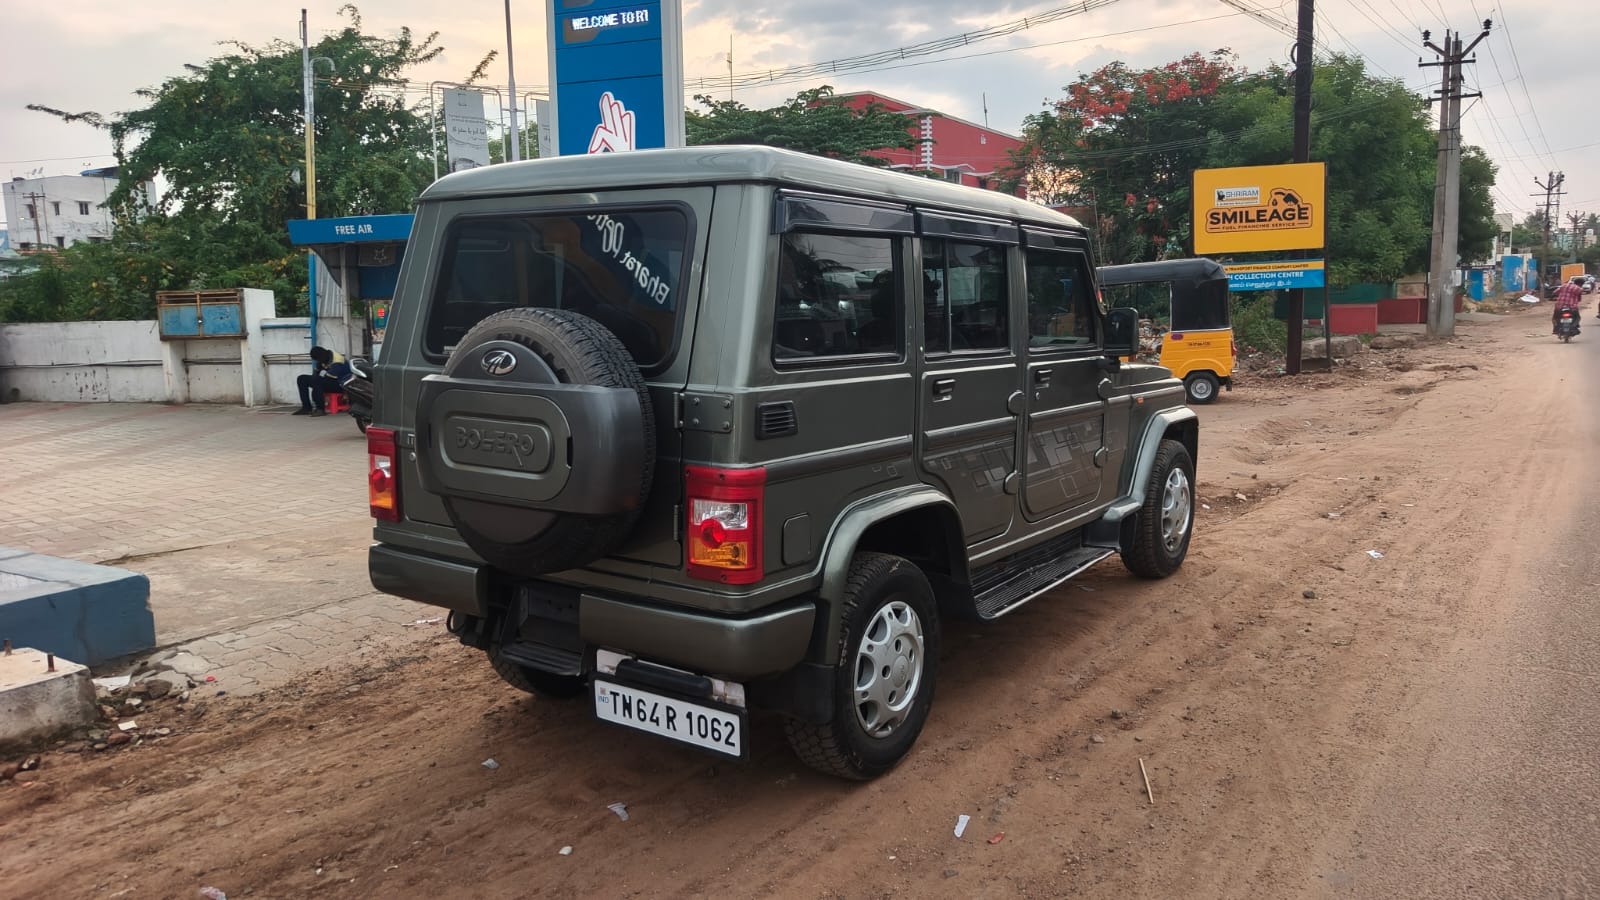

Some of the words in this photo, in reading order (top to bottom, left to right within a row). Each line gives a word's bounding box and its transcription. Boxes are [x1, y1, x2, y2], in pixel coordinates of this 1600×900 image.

[572, 13, 618, 30] WELCOME
[1225, 190, 1259, 198] SHRIRAM
[1209, 207, 1309, 225] SMILEAGE
[335, 225, 356, 235] FREE
[358, 224, 373, 234] AIR
[1234, 272, 1277, 280] COLLECTION
[1277, 271, 1304, 279] CENTRE
[455, 427, 535, 466] BOLERO
[685, 711, 736, 747] 1062
